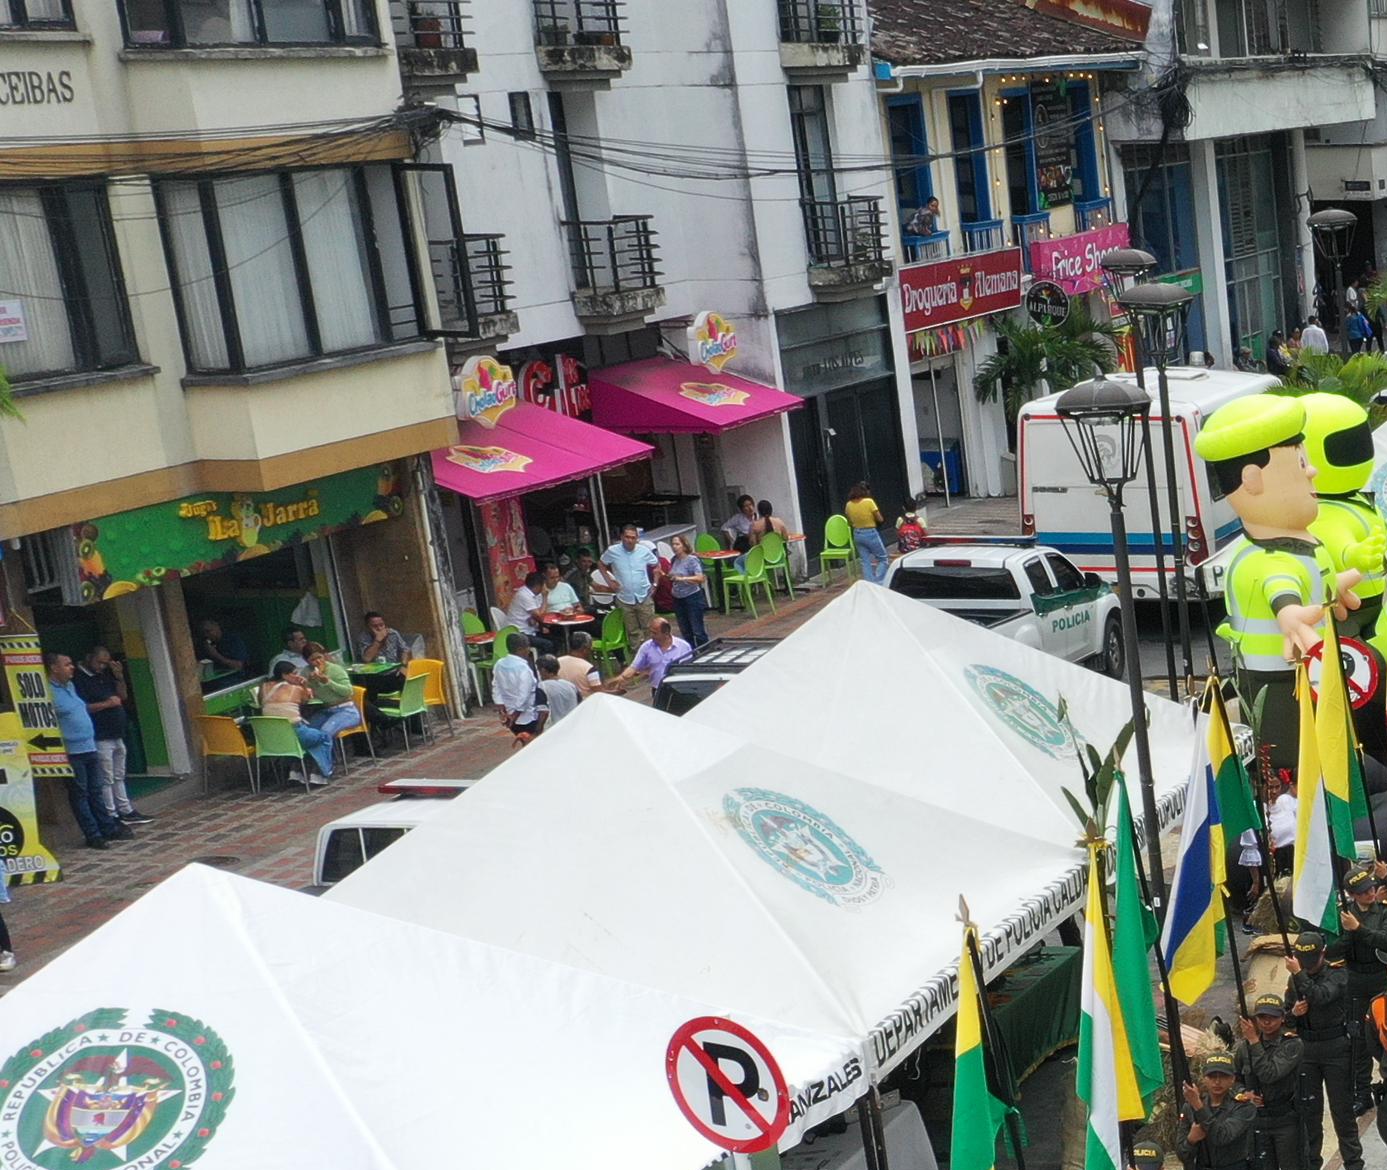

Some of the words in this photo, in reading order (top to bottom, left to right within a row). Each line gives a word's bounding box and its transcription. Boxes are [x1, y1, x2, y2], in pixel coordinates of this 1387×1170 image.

[1052, 250, 1083, 281] Price
[904, 279, 957, 316] Droguería
[974, 269, 1019, 299] Alemana
[263, 498, 319, 527] Jarra
[1052, 610, 1090, 633] POLICIA
[16, 672, 45, 700] SOLO
[18, 702, 57, 729] MOTOS
[1043, 863, 1090, 914] CALDA
[3, 1034, 93, 1122] REPUBLICA
[118, 1031, 148, 1044] DE
[163, 1040, 203, 1123] COLOMBIA
